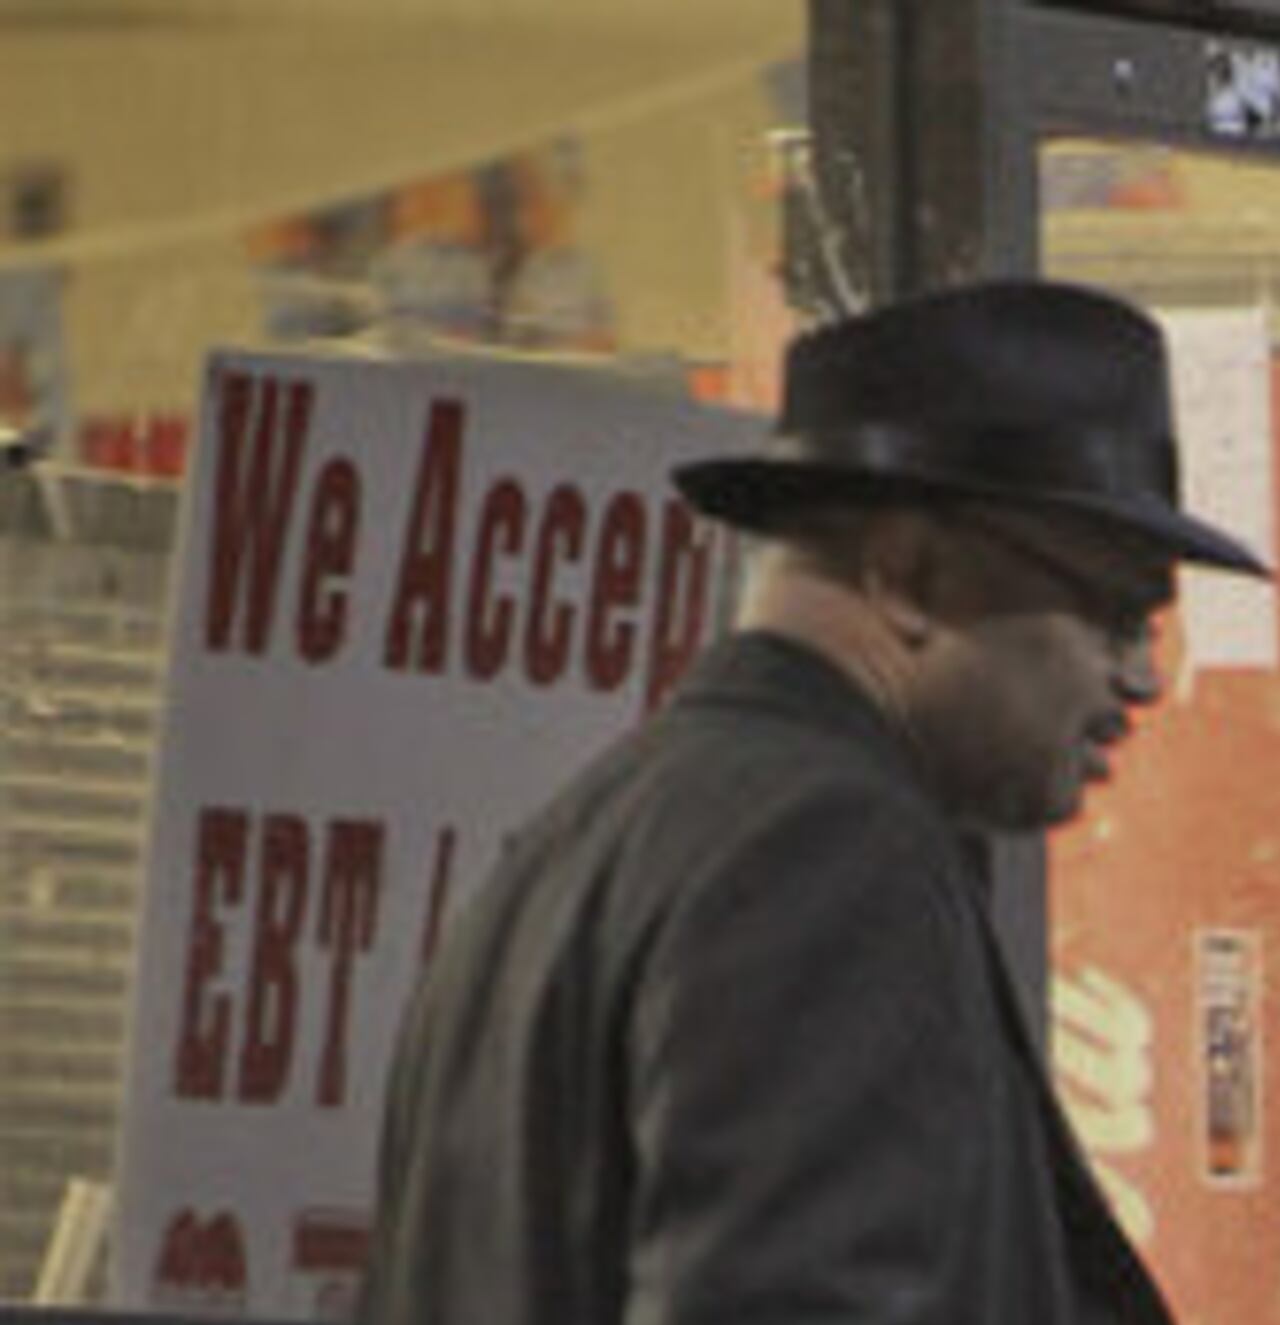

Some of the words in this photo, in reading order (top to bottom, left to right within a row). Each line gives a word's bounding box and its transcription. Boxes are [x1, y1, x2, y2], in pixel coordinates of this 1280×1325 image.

[205, 372, 361, 666] We
[384, 400, 712, 712] Accep
[173, 808, 387, 1110] EBT
